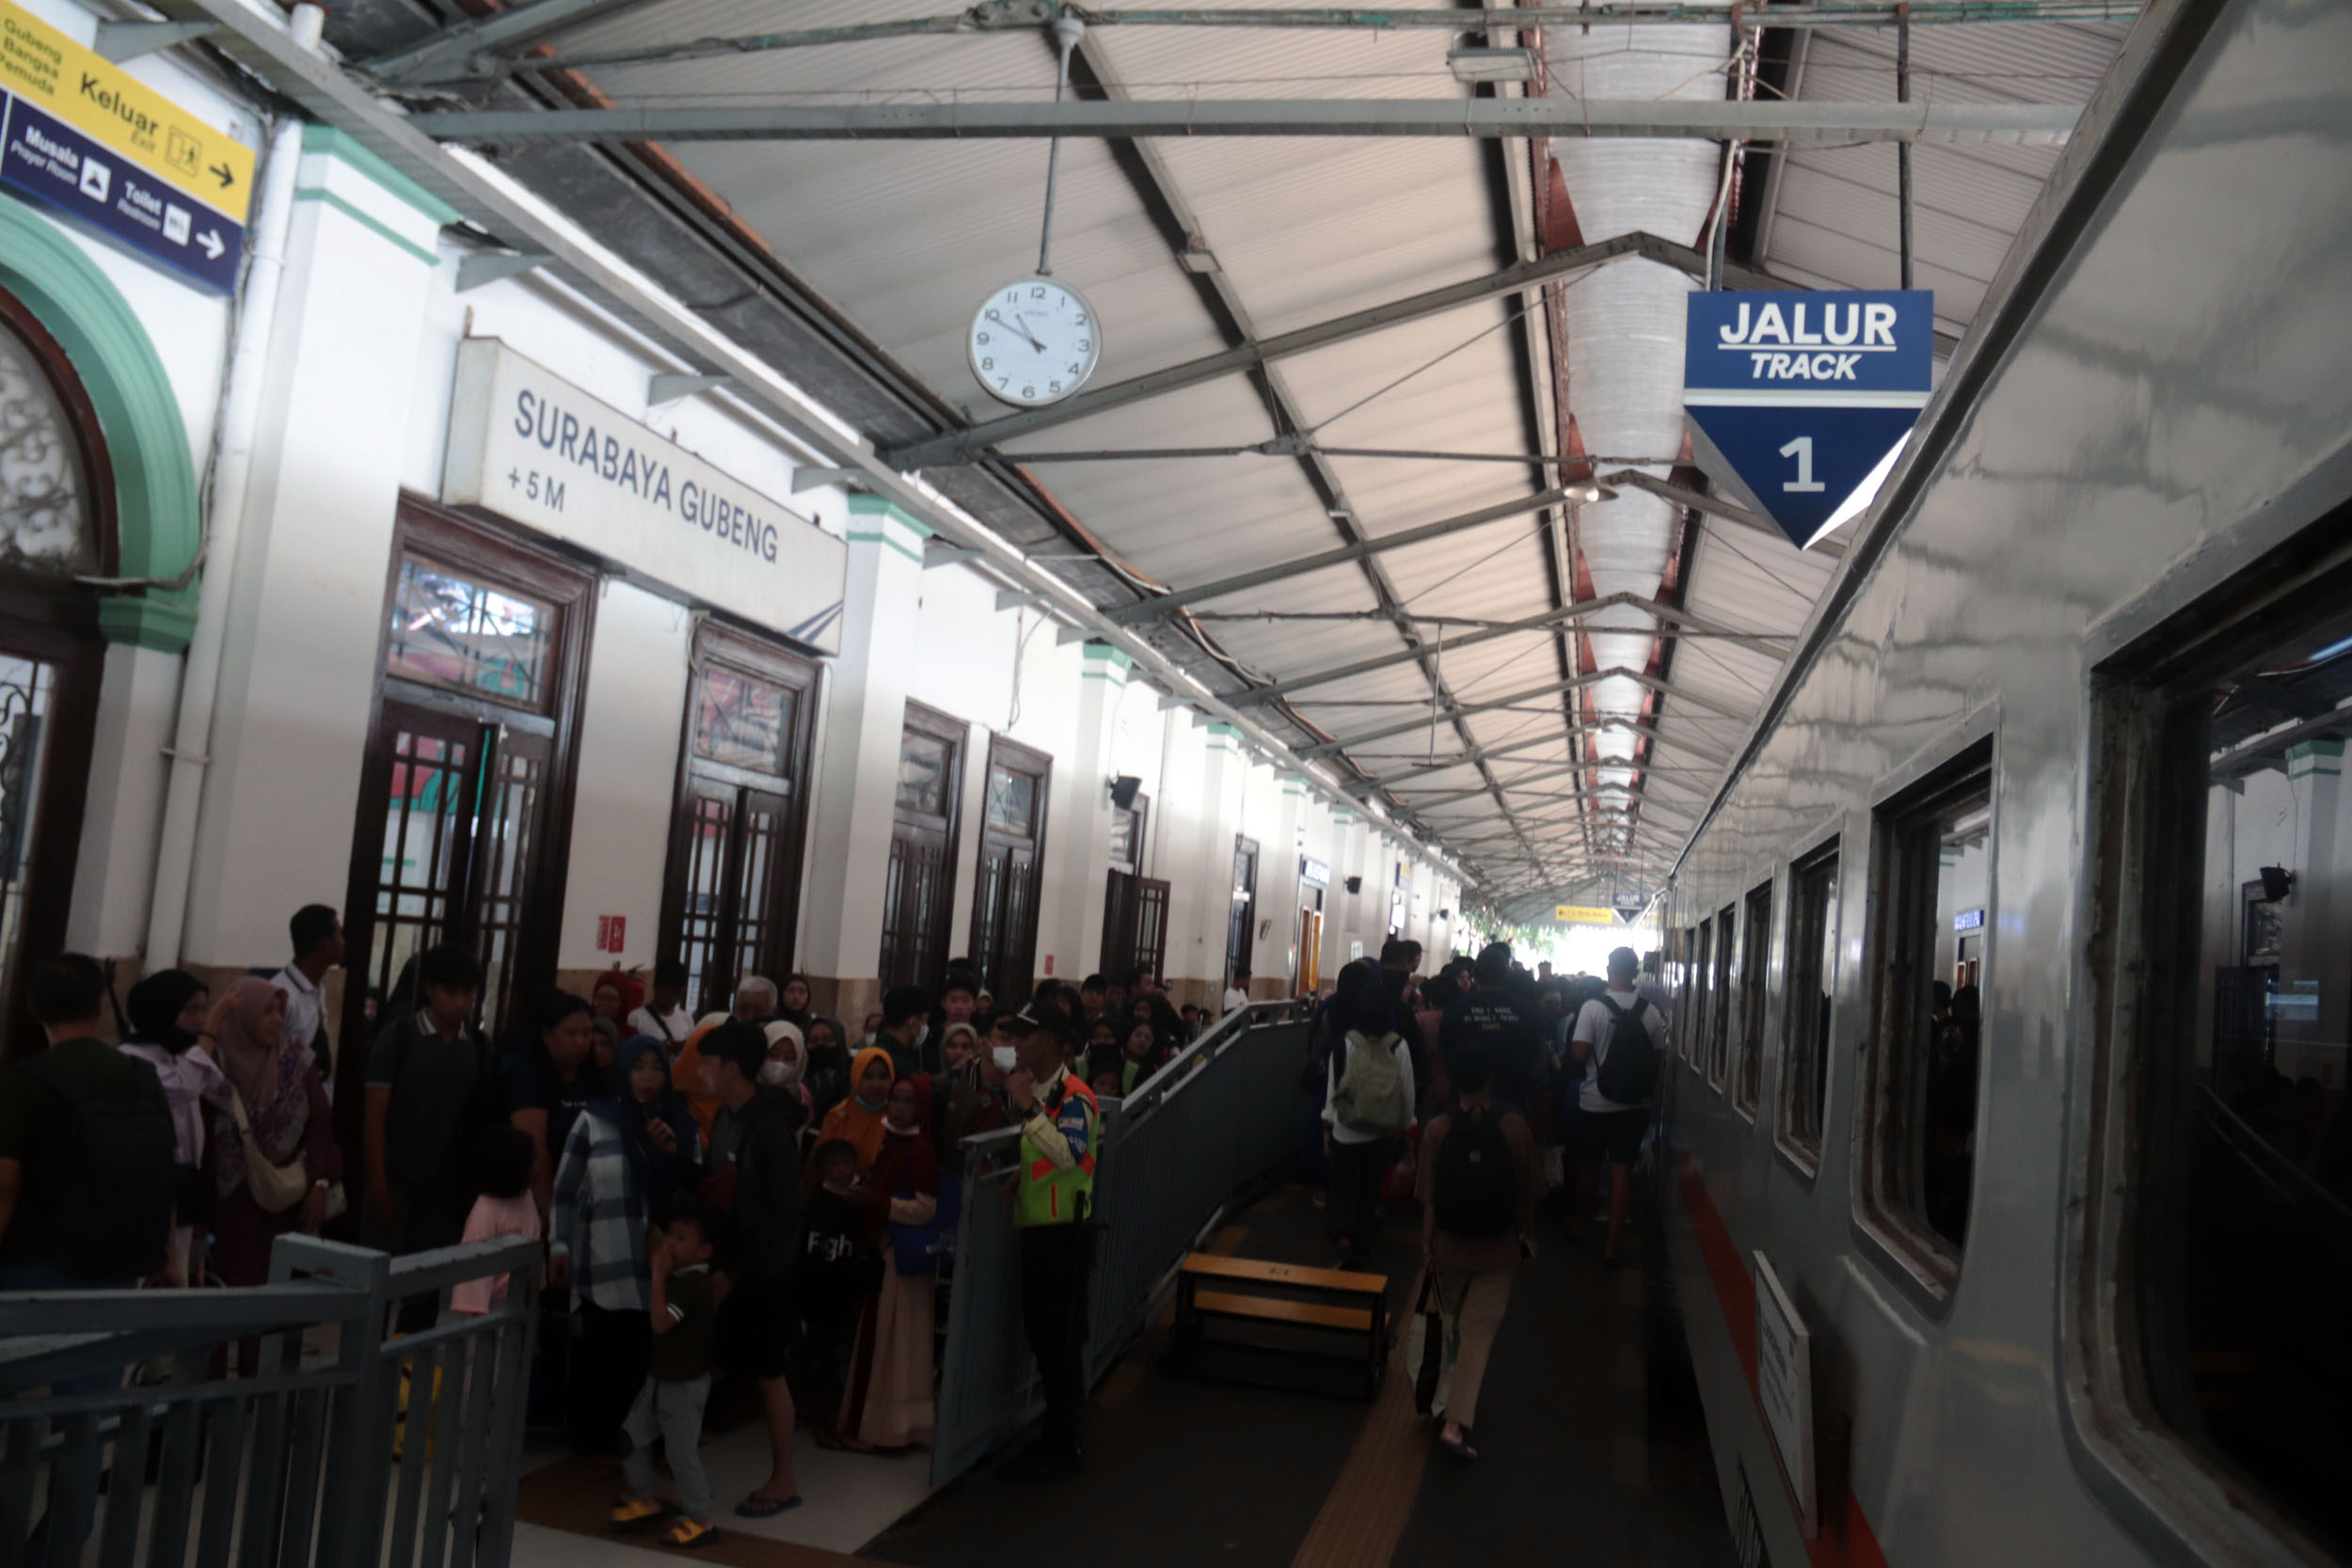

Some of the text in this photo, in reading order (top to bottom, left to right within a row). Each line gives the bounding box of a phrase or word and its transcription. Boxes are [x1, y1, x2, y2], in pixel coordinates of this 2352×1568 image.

[4, 18, 62, 65] Gubeng
[4, 36, 58, 79] Bangsa
[81, 71, 158, 135] Keluar
[25, 124, 79, 169] Musala
[125, 181, 162, 216] Toilet
[1007, 292, 1018, 304] 11
[1031, 286, 1046, 299] 12
[984, 309, 1000, 321] 10
[1074, 313, 1087, 326] 2
[1720, 302, 1898, 346] JALUR
[977, 332, 990, 345] 9
[1078, 339, 1089, 353] 3
[981, 356, 993, 371] 8
[1068, 361, 1079, 375] 4
[1751, 353, 1862, 380] TRACK
[997, 377, 1009, 390] 7
[1049, 380, 1061, 393] 5
[1022, 386, 1035, 399] 6
[1779, 436, 1825, 492] 1
[515, 389, 778, 564] SURABAYA GUBENG
